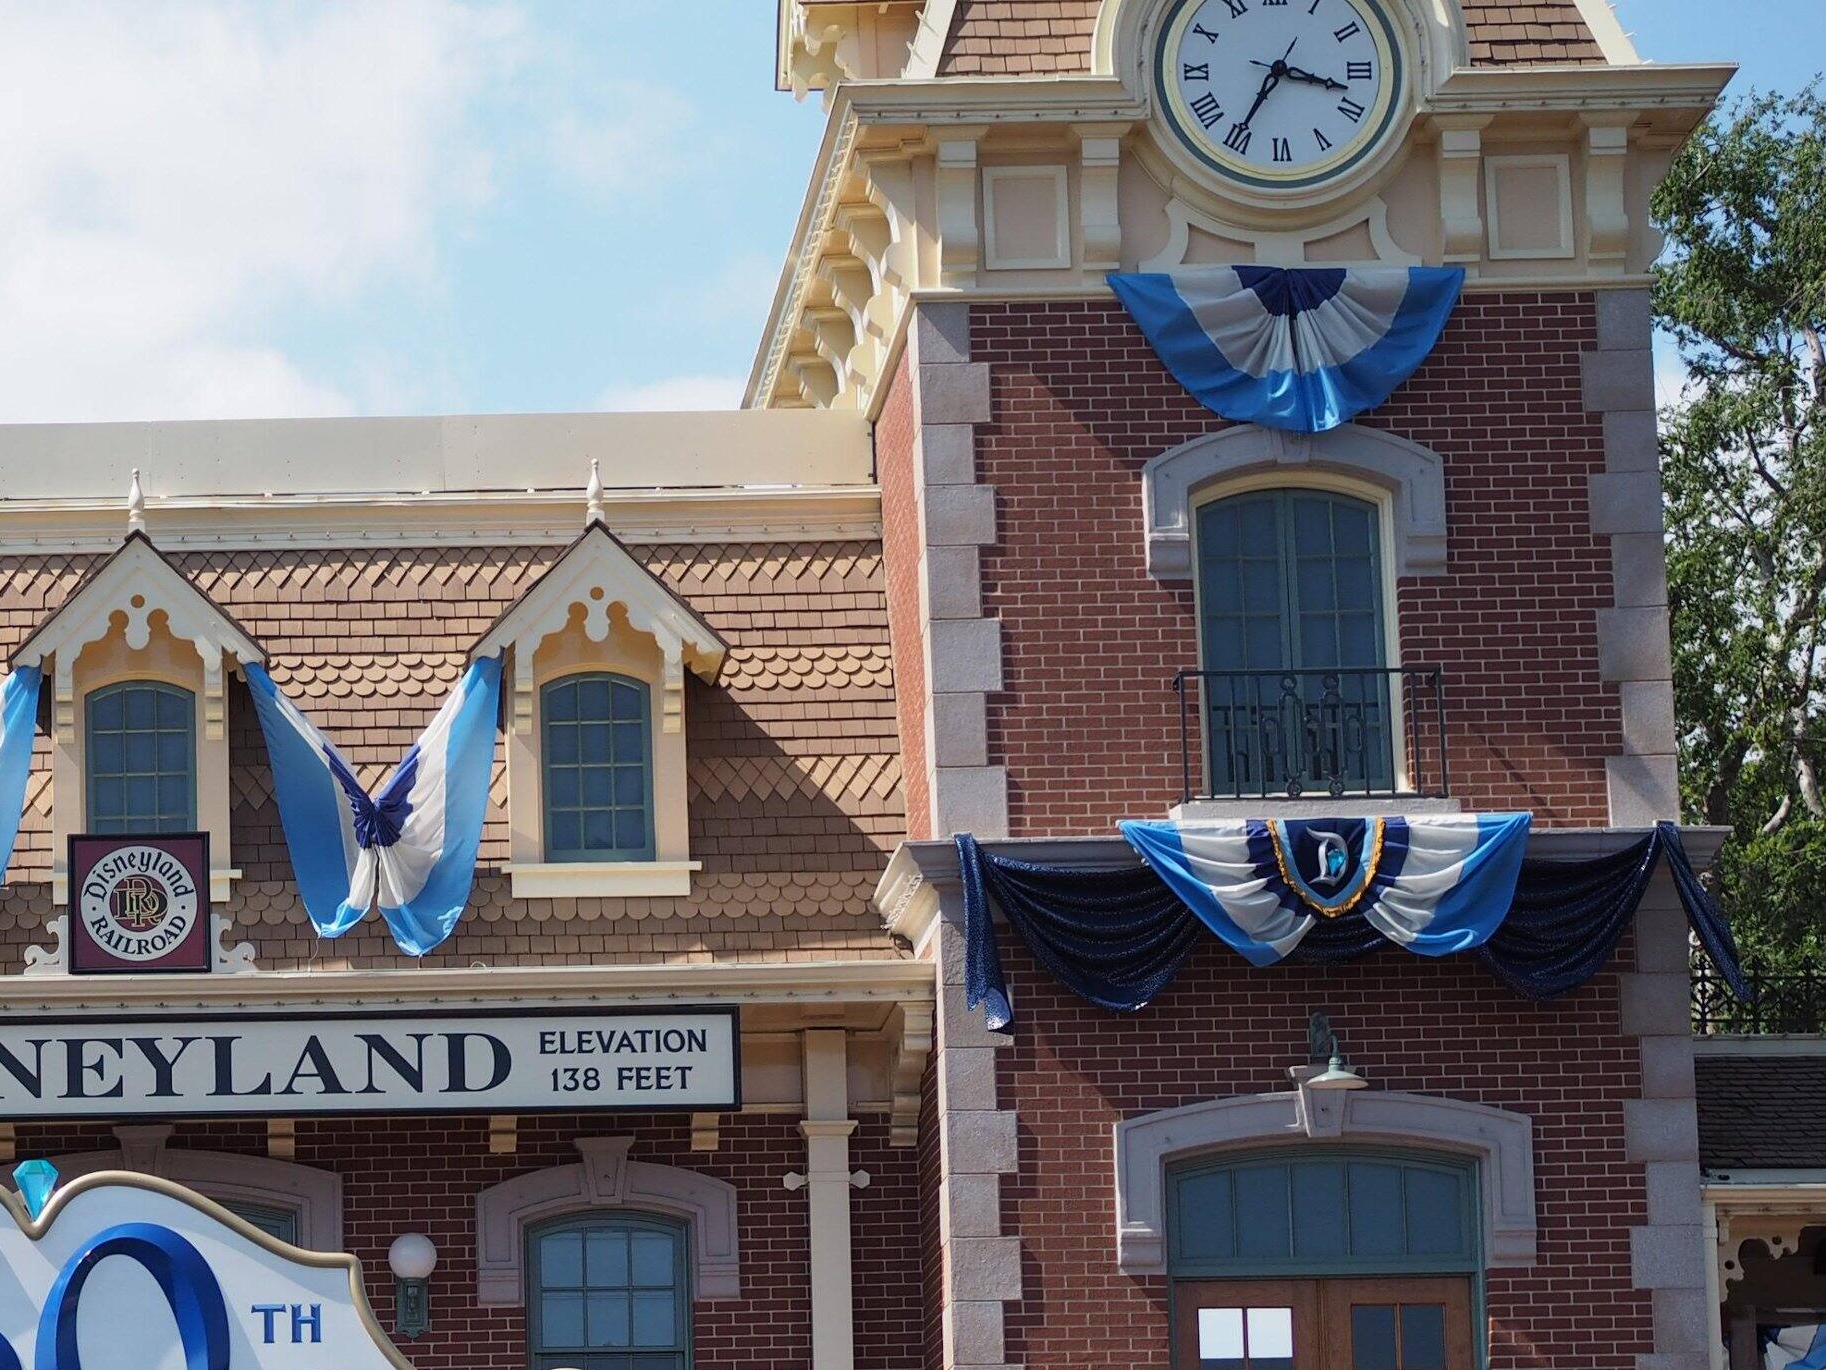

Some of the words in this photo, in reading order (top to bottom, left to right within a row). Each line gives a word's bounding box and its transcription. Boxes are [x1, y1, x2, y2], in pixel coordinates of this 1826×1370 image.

[1192, 22, 1219, 44] X
[1333, 21, 1360, 43] II
[1183, 62, 1209, 81] IX
[1346, 60, 1372, 80] III
[1190, 91, 1224, 130] VIII
[1337, 96, 1365, 123] IV
[1272, 137, 1292, 162] VI
[1313, 128, 1333, 151] V
[82, 851, 195, 902] Disneyland
[90, 914, 187, 956] RAILROAD
[539, 1028, 708, 1056] ELEVATION
[550, 1065, 601, 1092] 138
[617, 1065, 693, 1091] FEET
